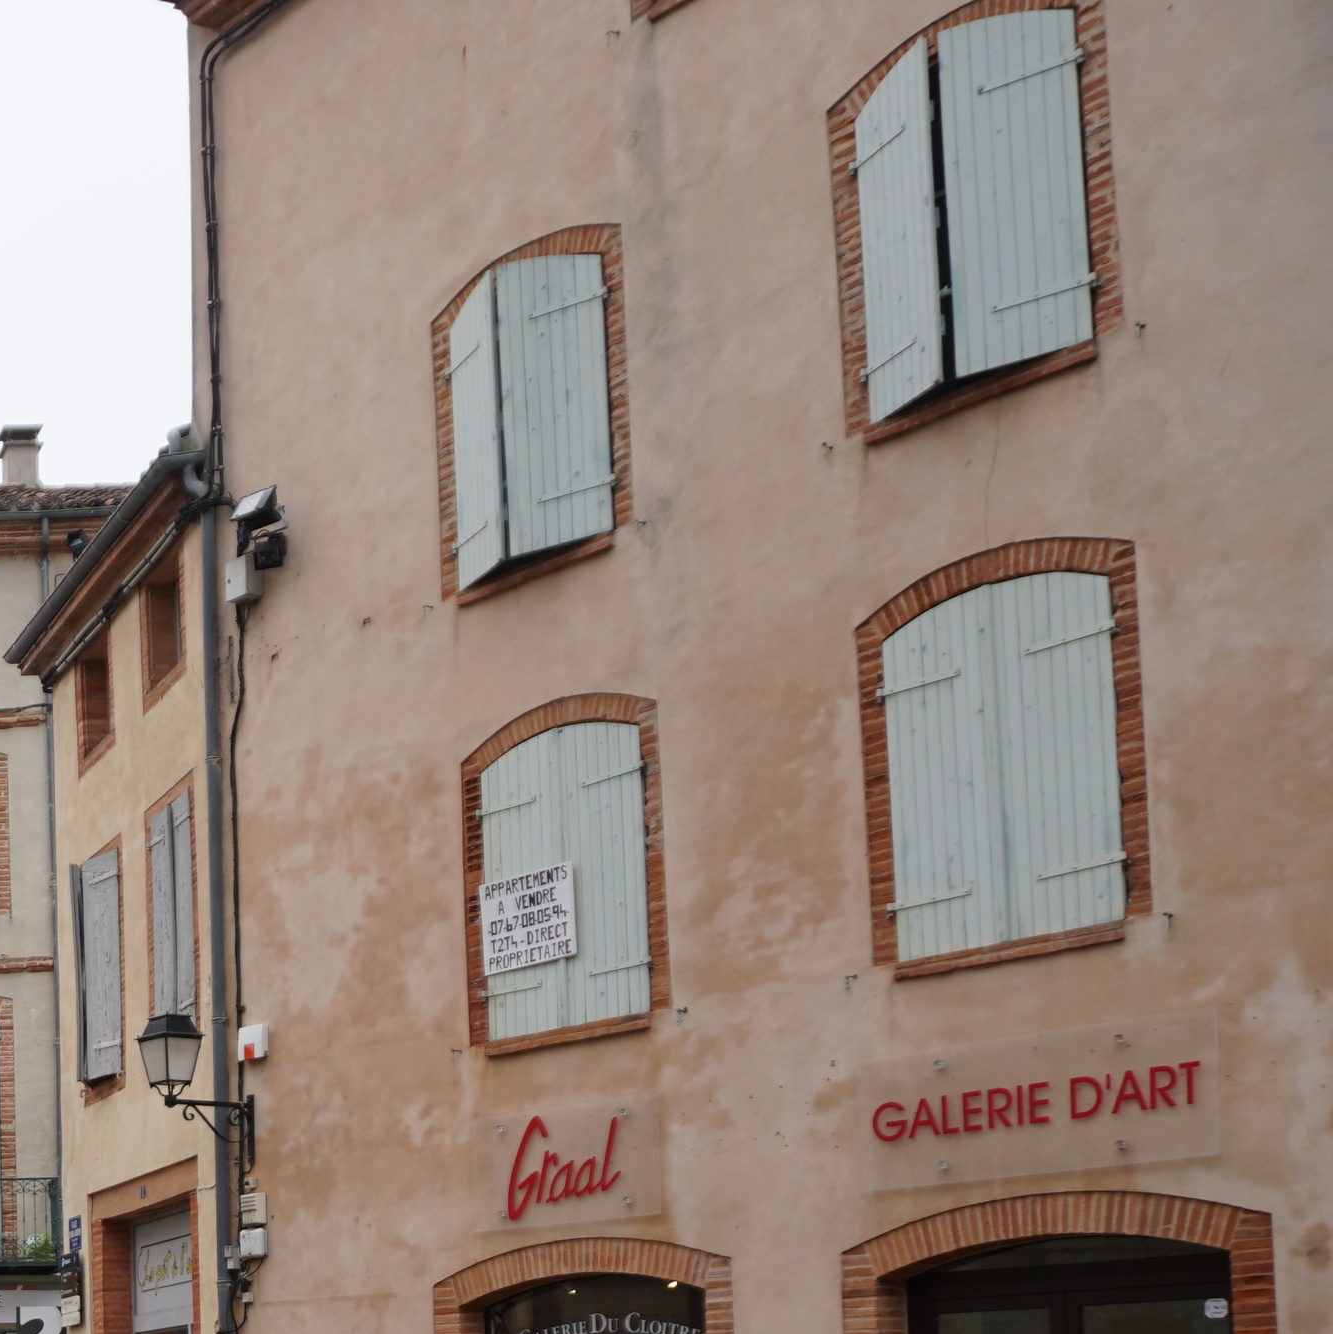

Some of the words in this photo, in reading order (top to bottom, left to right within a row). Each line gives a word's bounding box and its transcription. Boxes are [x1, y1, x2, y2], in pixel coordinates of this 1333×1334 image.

[485, 864, 568, 900] APPARTEMENTS
[498, 901, 505, 915] A
[515, 886, 557, 910] VENDRE
[489, 939, 572, 972] PROPRIETAIRE
[872, 1081, 1051, 1142] GALERIE
[1069, 1060, 1201, 1119] D'ART
[507, 1114, 622, 1220] Graal
